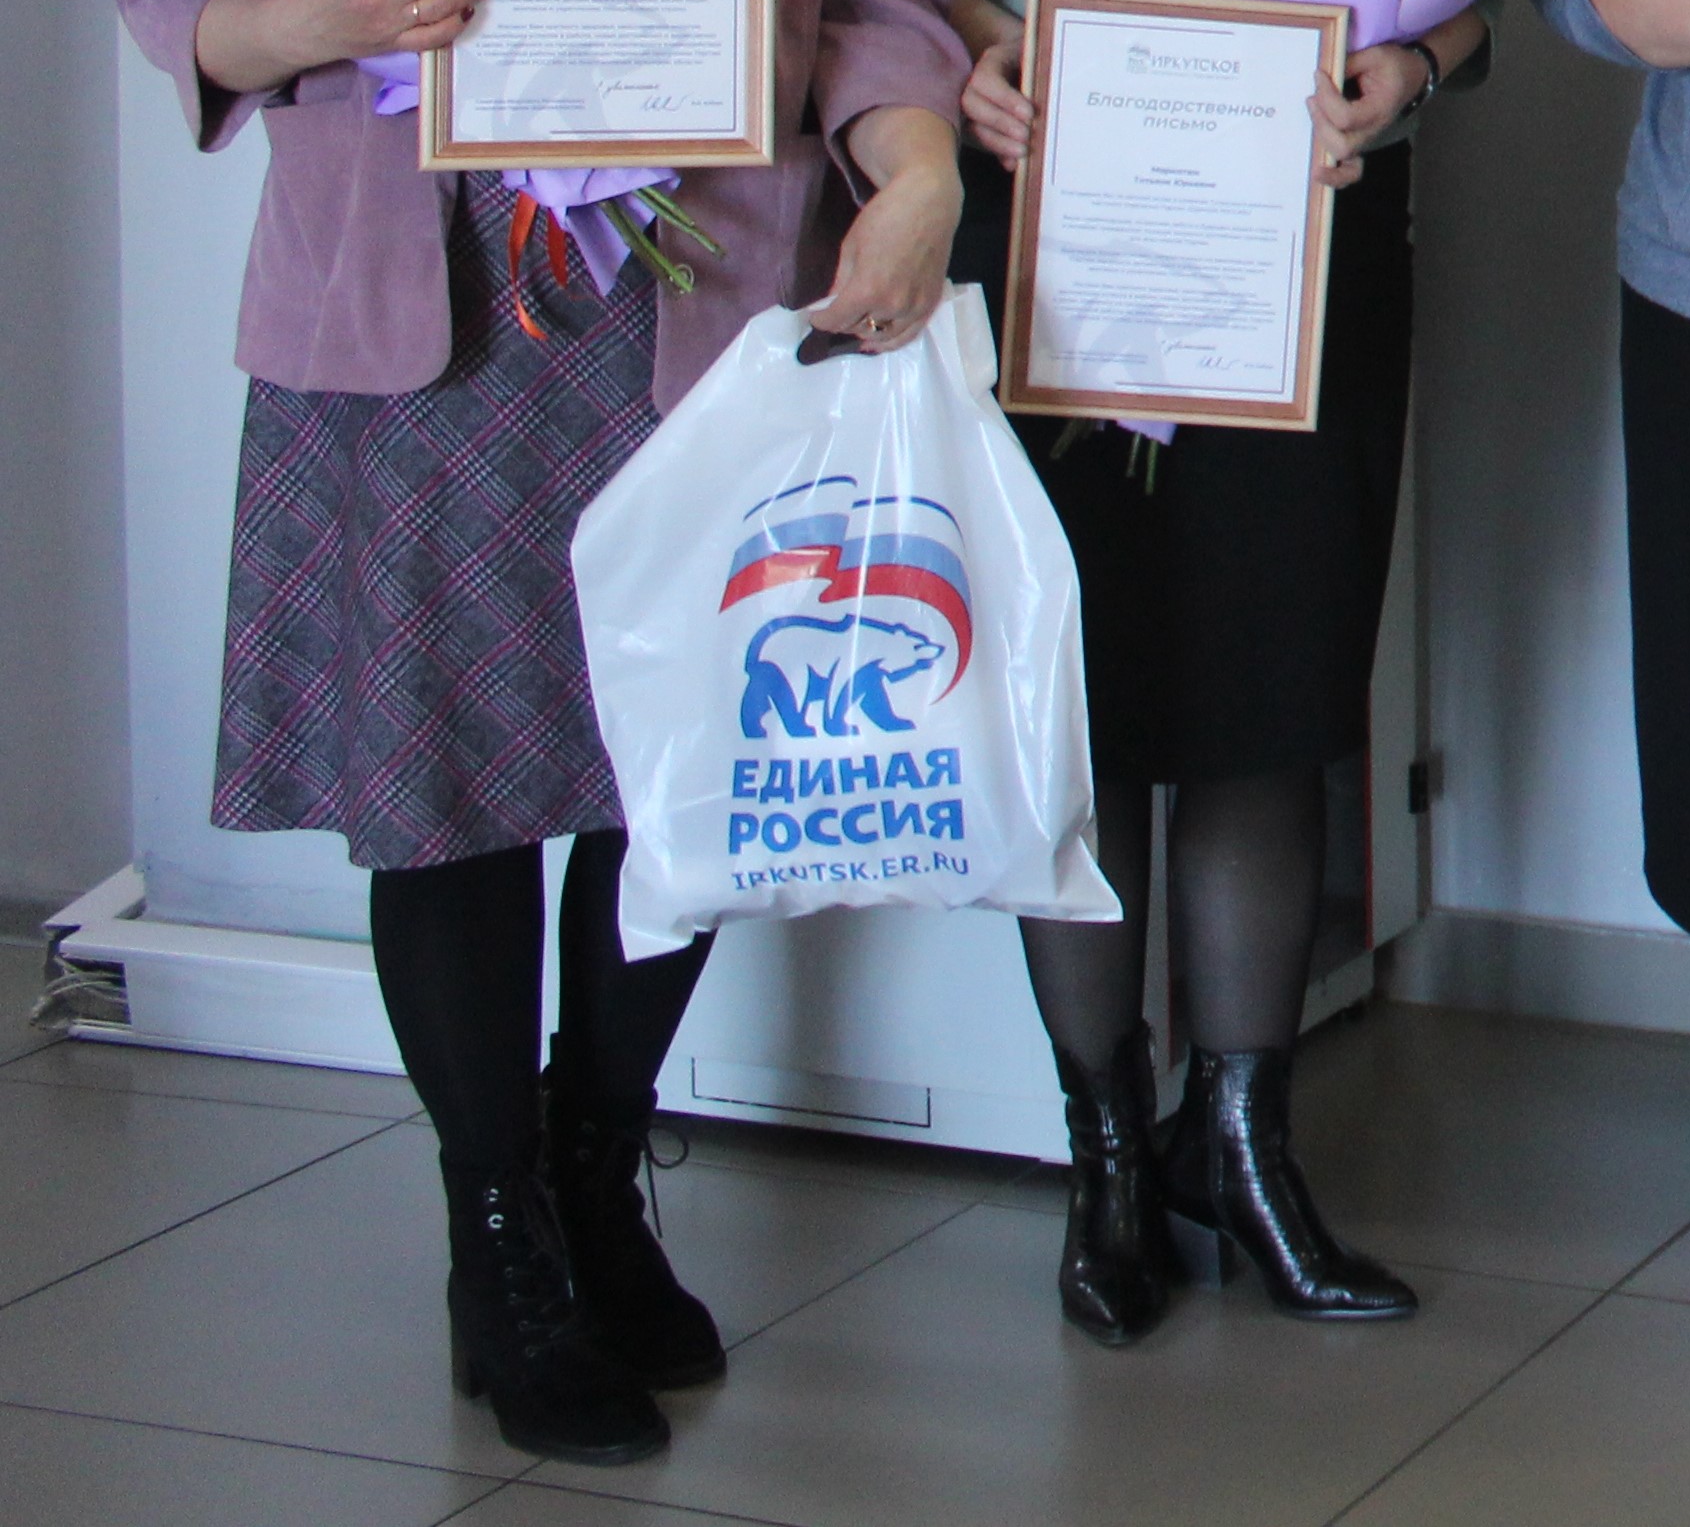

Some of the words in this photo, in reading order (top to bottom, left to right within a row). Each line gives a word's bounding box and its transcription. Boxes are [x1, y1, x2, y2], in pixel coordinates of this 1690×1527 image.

[1150, 55, 1242, 75] ИРКУТСКОЕ
[1087, 91, 1278, 119] Благодарственное
[1142, 116, 1219, 132] письмо
[731, 747, 963, 805] ЕДИНАЯ
[728, 799, 966, 856] РОССИЯ
